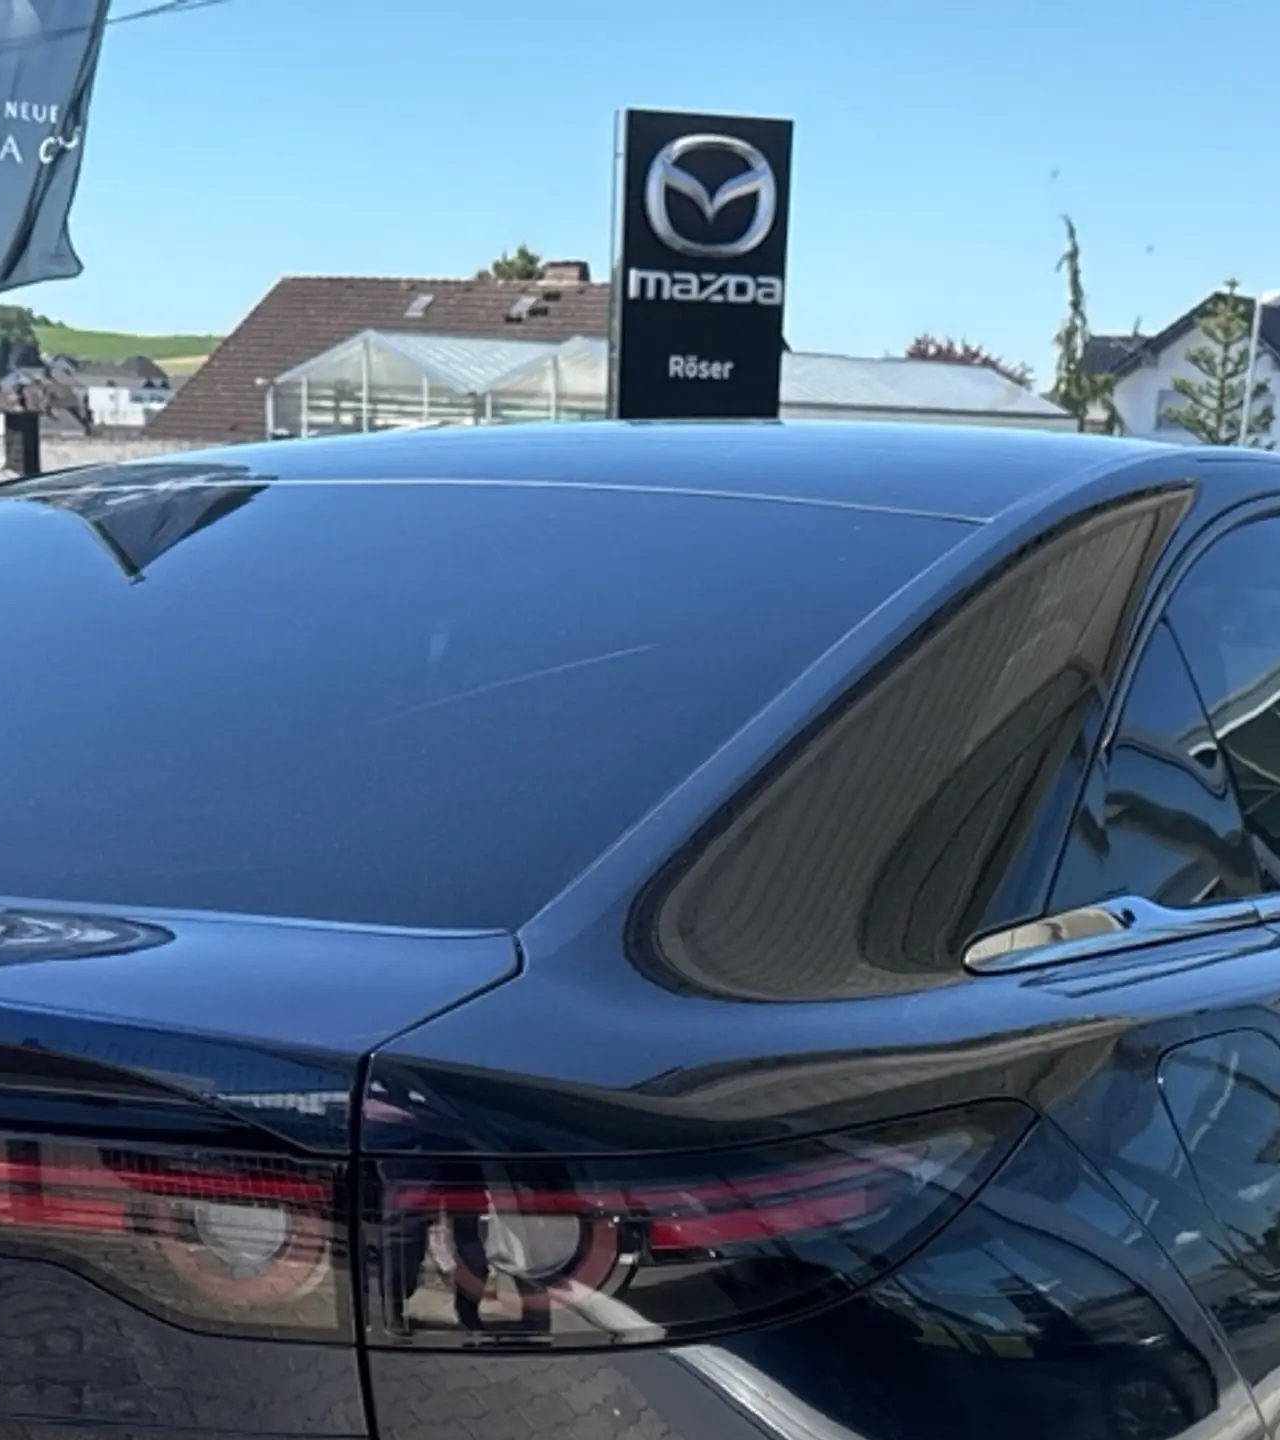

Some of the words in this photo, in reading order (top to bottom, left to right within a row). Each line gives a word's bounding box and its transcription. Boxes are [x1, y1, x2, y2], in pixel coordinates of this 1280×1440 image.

[5, 101, 59, 124] NEUE
[629, 267, 782, 305] mazda
[669, 354, 734, 380] Röser
